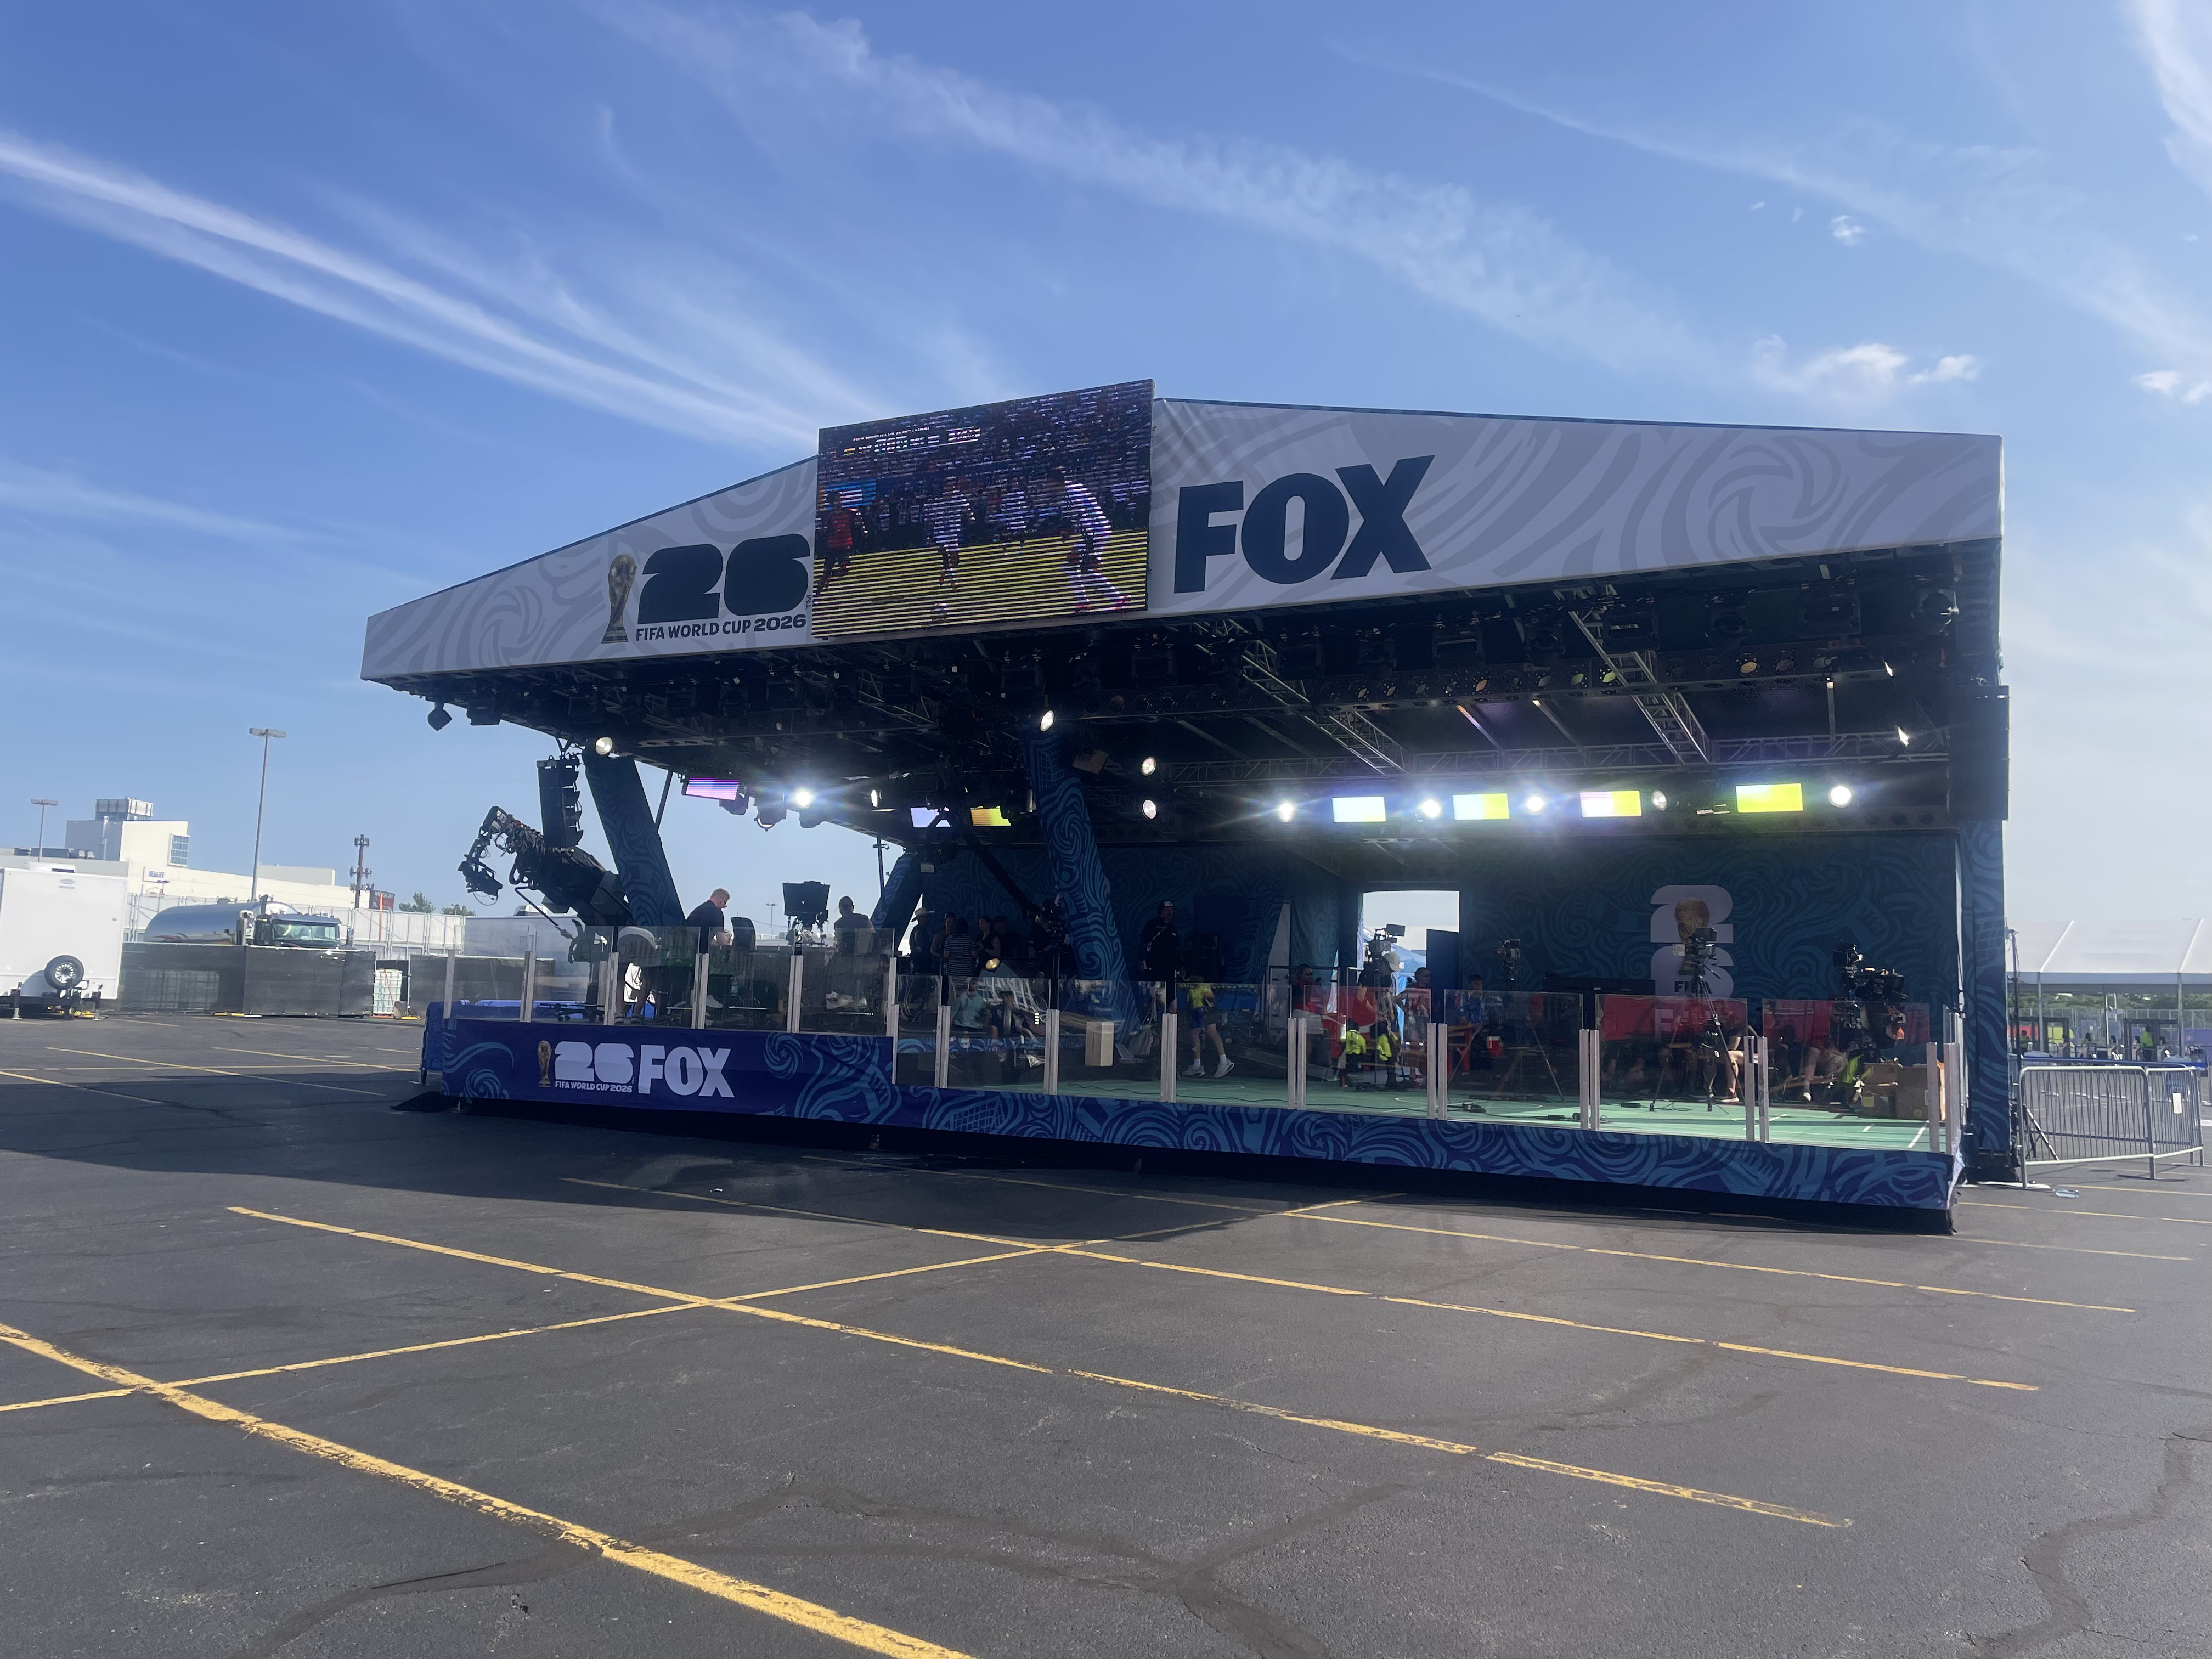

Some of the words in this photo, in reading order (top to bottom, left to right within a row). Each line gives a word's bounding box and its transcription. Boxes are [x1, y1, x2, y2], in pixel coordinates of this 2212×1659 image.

[1174, 455, 1435, 594] FOX
[637, 533, 810, 624] 26
[635, 627, 665, 641] FIFA
[668, 622, 720, 638] WORLD
[722, 620, 752, 634] CUP
[754, 614, 806, 632] 2026
[555, 1041, 634, 1084] 26
[638, 1045, 735, 1097] FOX
[571, 1082, 595, 1090] WORLD
[596, 1083, 610, 1091] CUP
[610, 1084, 633, 1093] 2026
